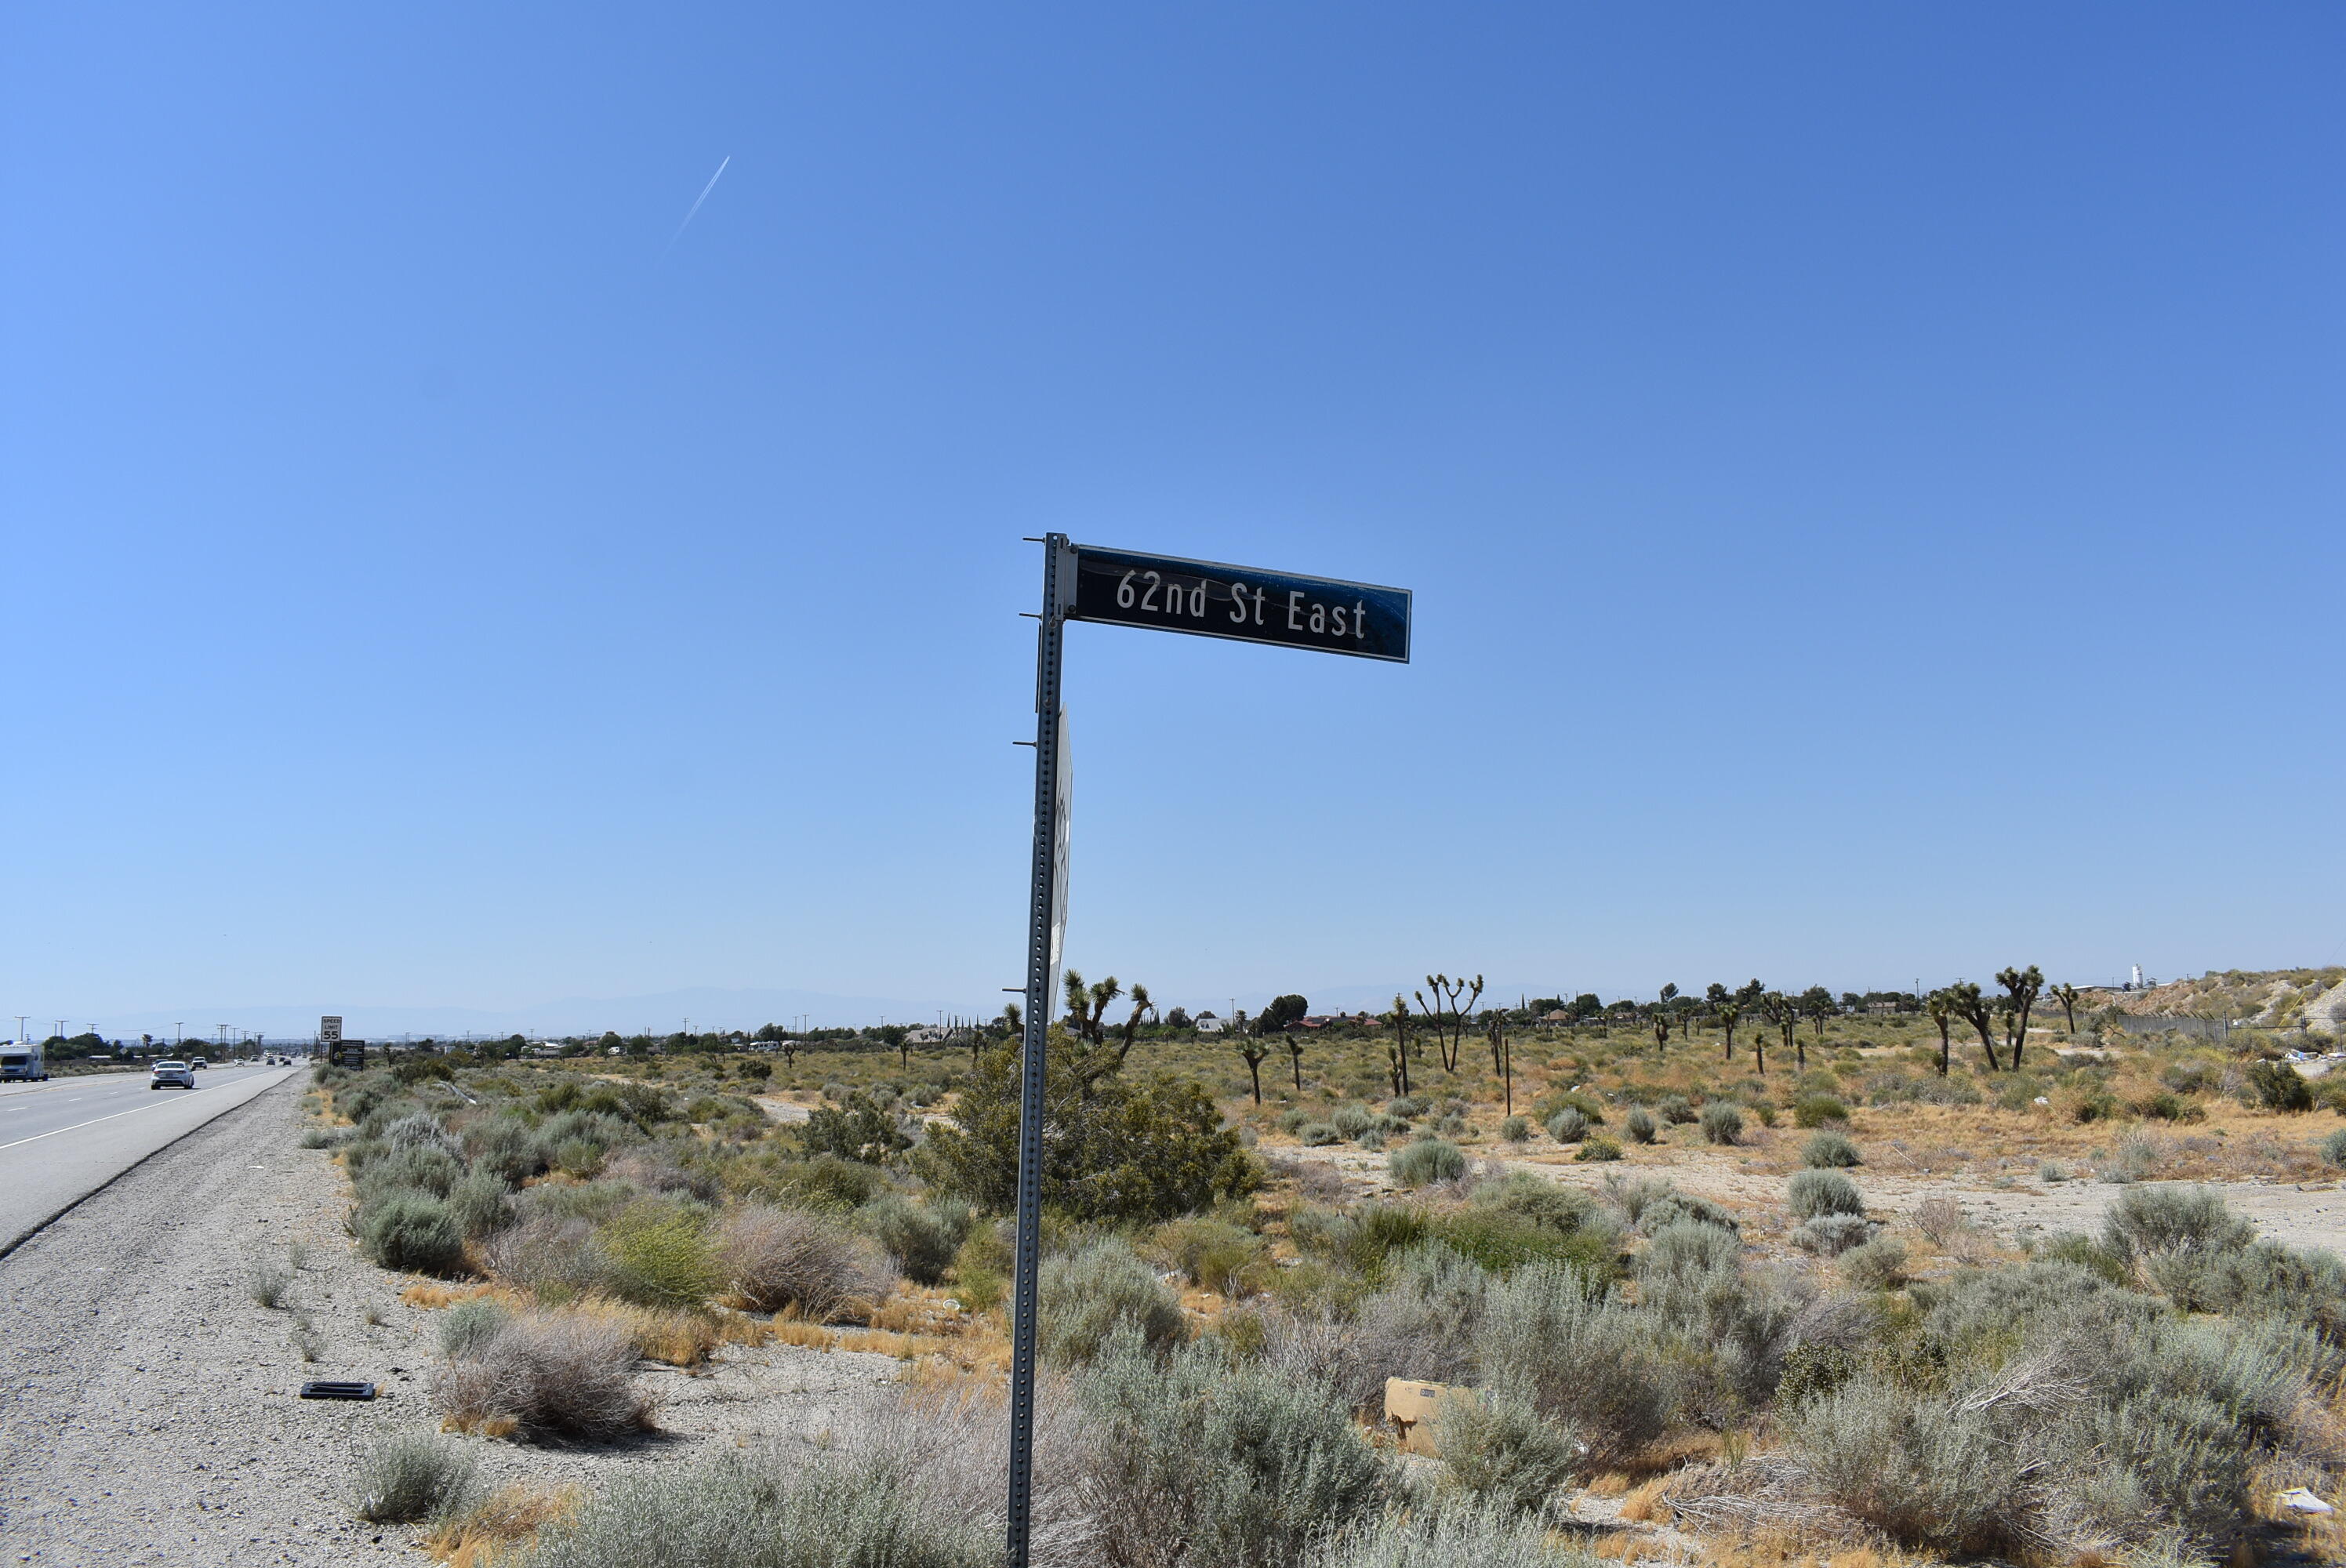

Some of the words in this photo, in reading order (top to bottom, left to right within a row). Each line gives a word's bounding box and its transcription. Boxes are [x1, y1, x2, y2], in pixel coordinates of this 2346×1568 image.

[1116, 570, 1208, 618] 62nd
[1229, 583, 1266, 626] St
[1287, 590, 1366, 639] East
[323, 1031, 339, 1040] 55
